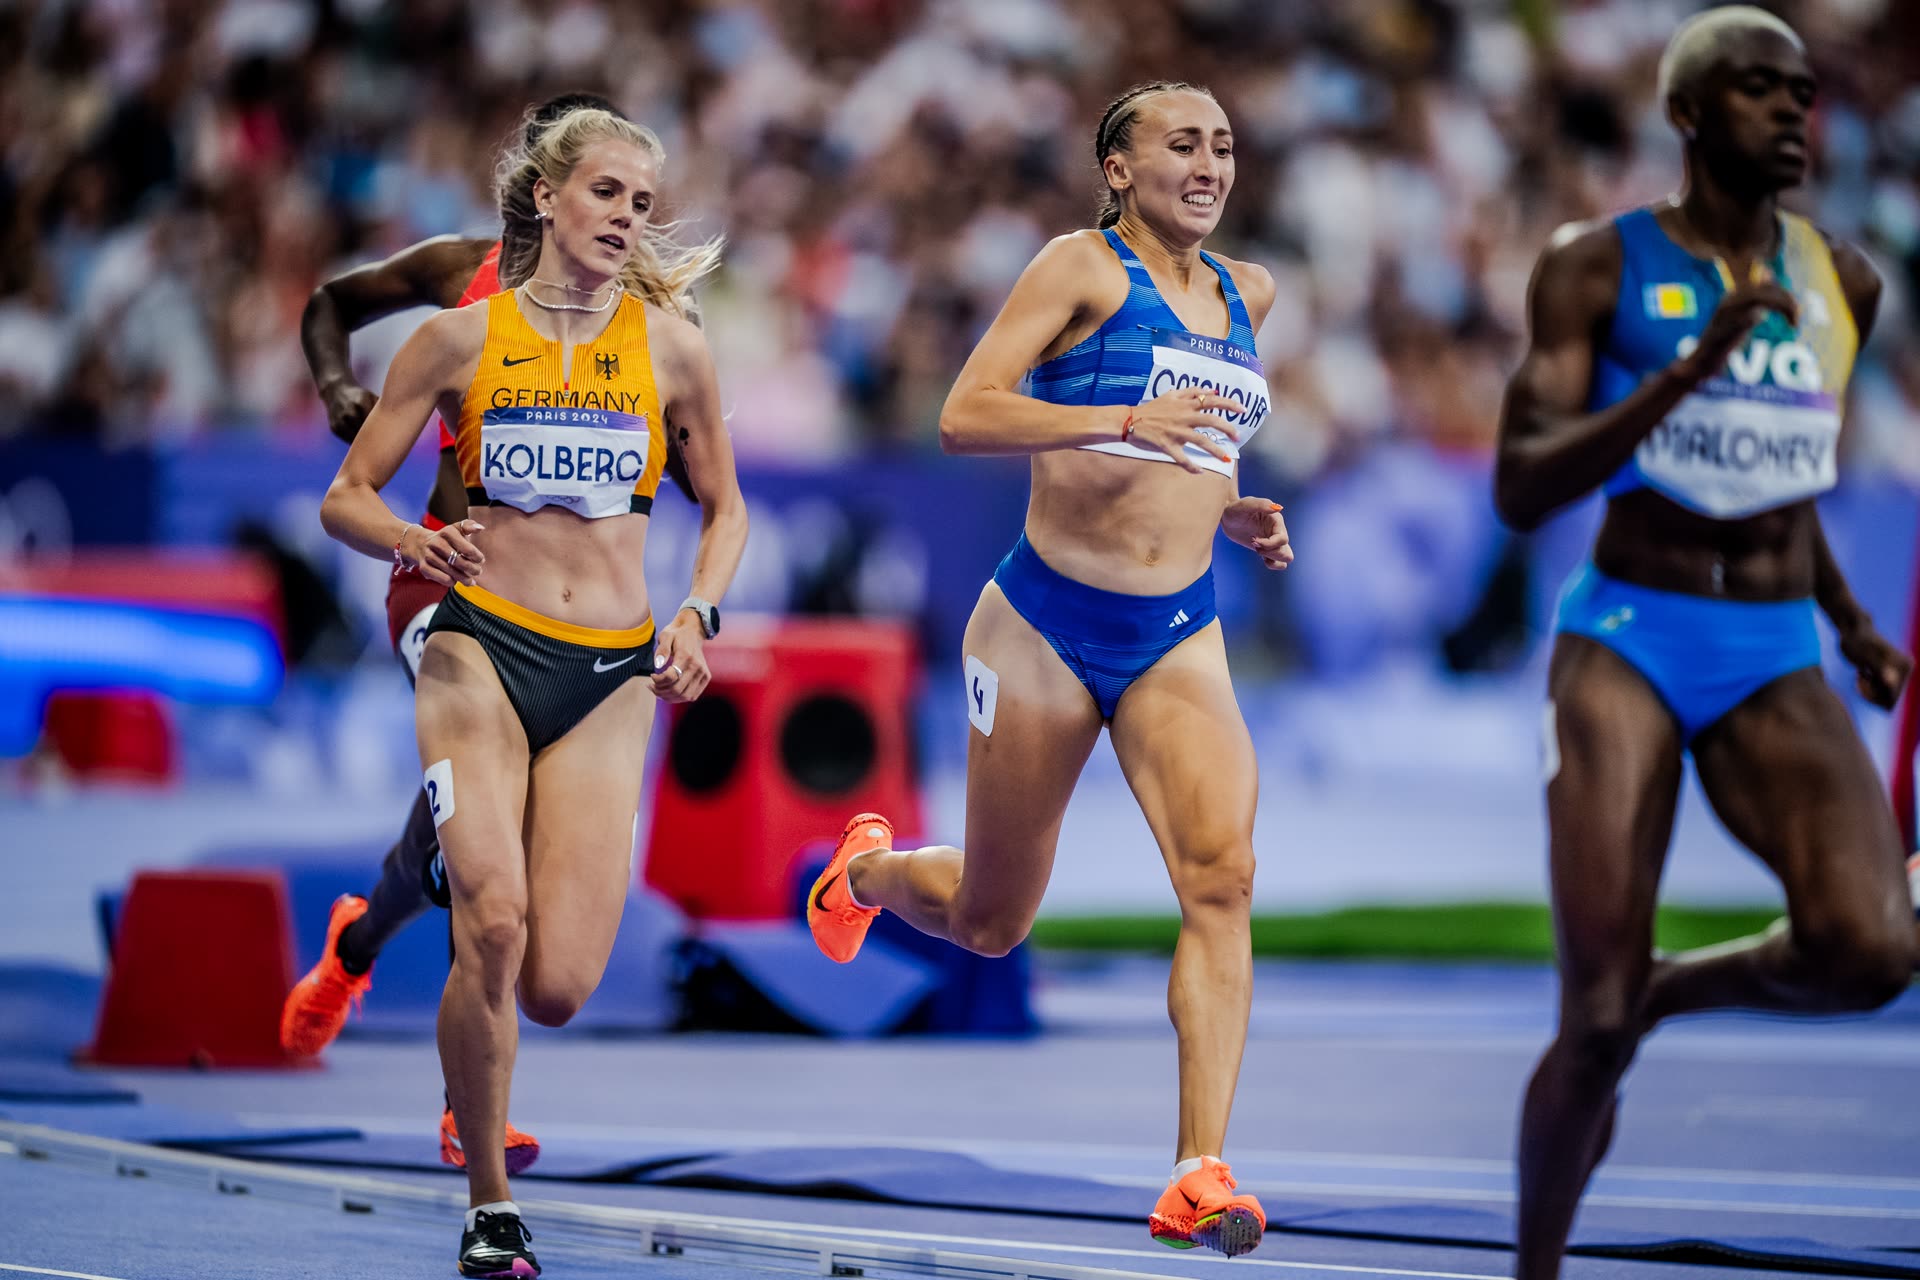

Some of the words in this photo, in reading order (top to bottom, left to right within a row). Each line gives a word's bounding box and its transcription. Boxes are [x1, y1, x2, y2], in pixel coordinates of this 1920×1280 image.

[1190, 338, 1223, 354] PARIS
[1228, 347, 1250, 363] 2024
[1676, 335, 1823, 393] VG
[491, 387, 641, 414] GERMANY
[526, 411, 567, 421] PARIS
[572, 413, 608, 424] 2024
[484, 443, 643, 482] KOLBERG
[973, 676, 984, 715] 4
[428, 780, 440, 817] 2
